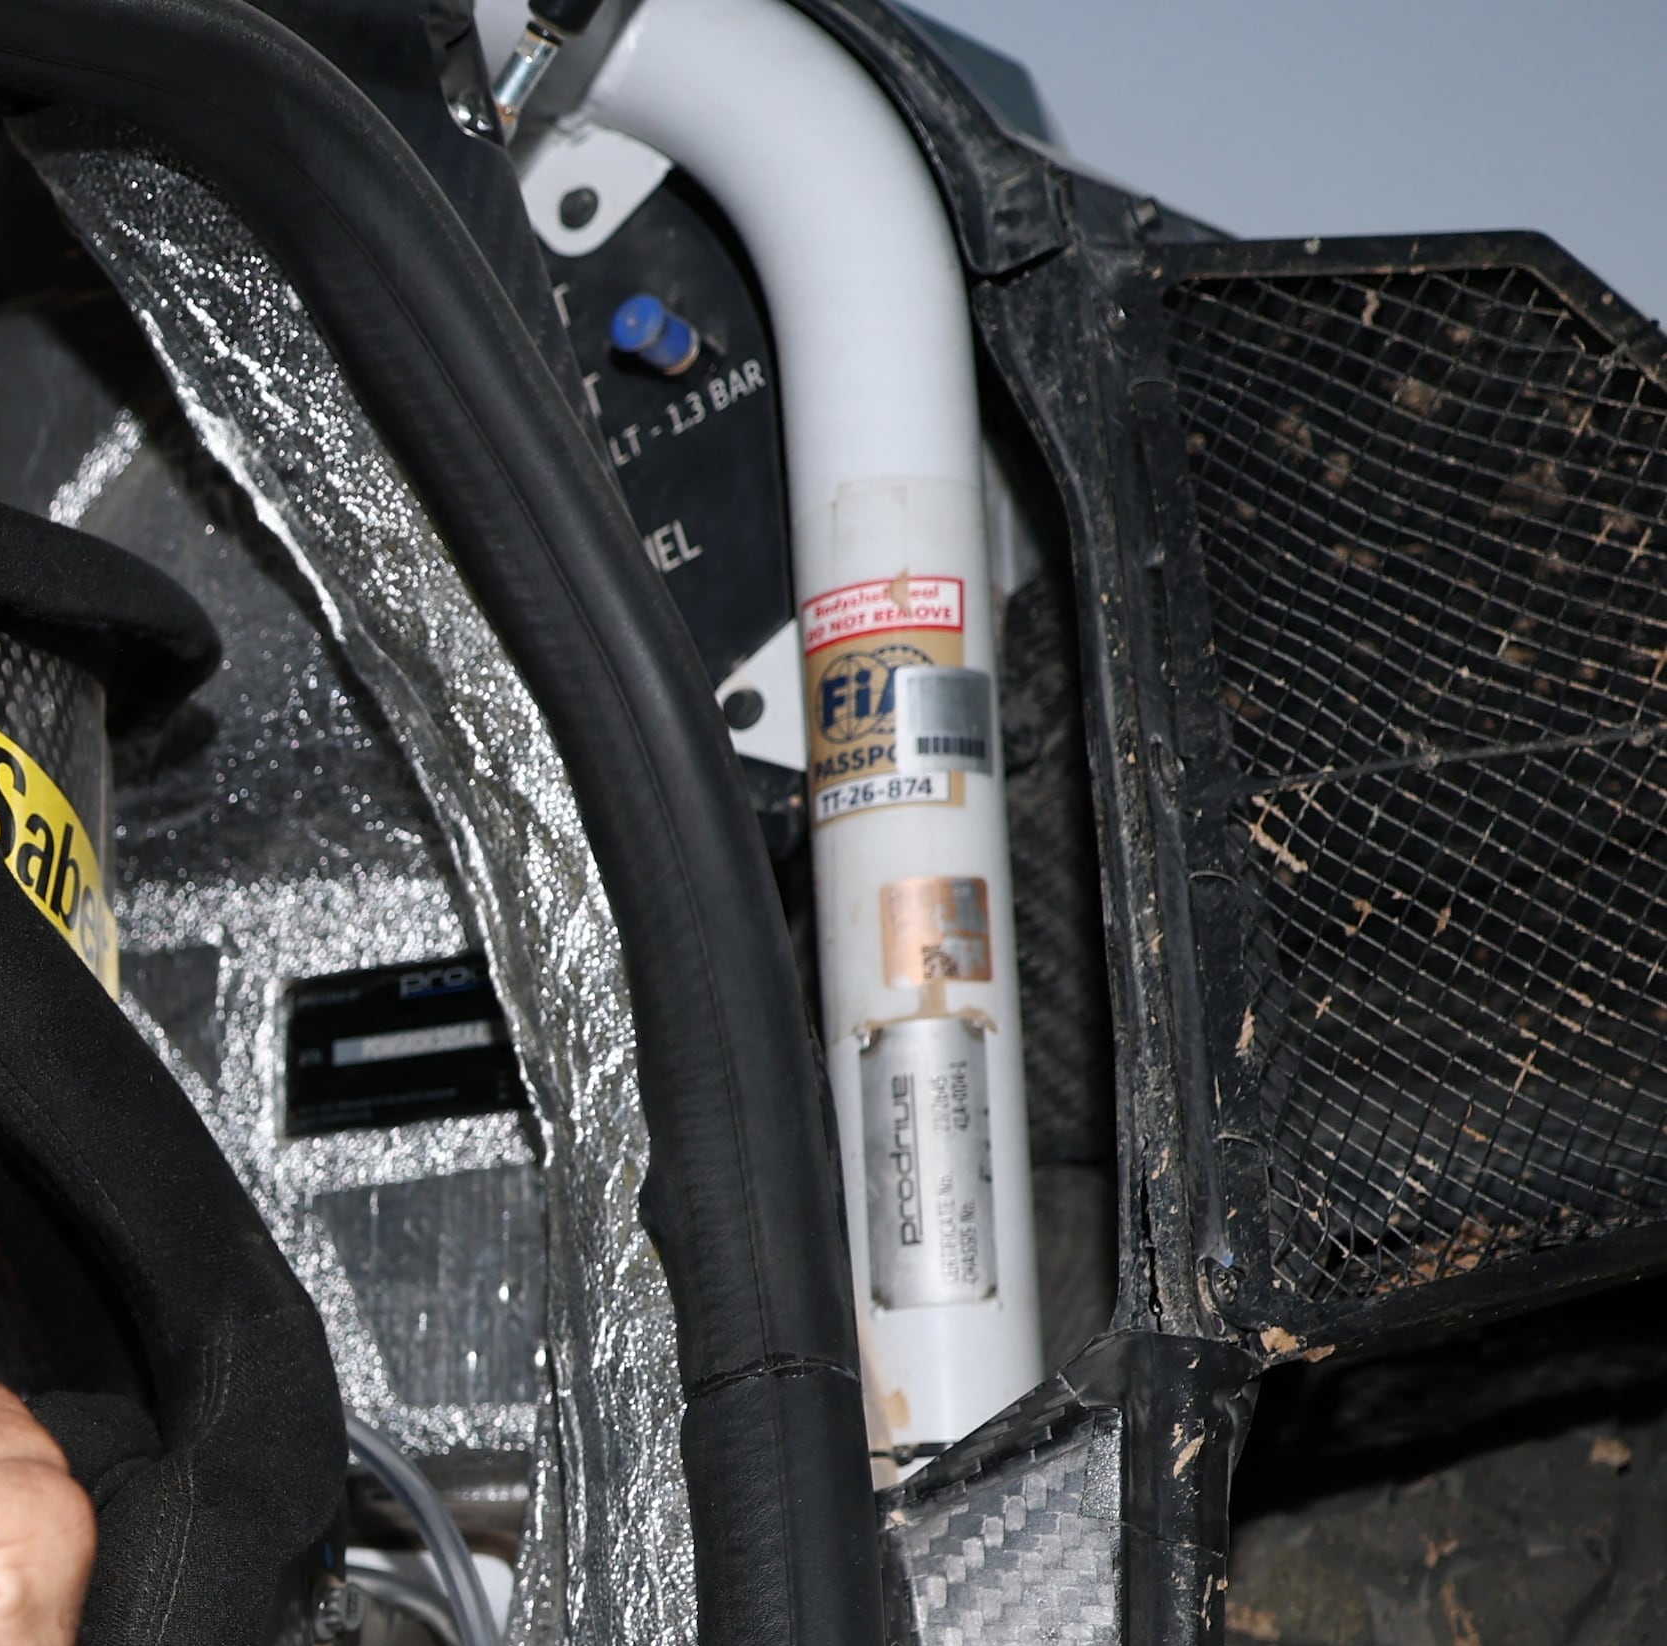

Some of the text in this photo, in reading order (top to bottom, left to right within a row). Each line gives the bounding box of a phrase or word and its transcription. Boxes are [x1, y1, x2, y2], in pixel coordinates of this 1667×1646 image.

[666, 390, 707, 435] 1.3
[708, 358, 767, 411] BAR
[830, 613, 867, 633] NOT
[873, 604, 954, 624] REMOVE
[814, 744, 897, 781] PASSP
[820, 777, 934, 813] TT-26-874
[888, 1073, 923, 1247] prodrive
